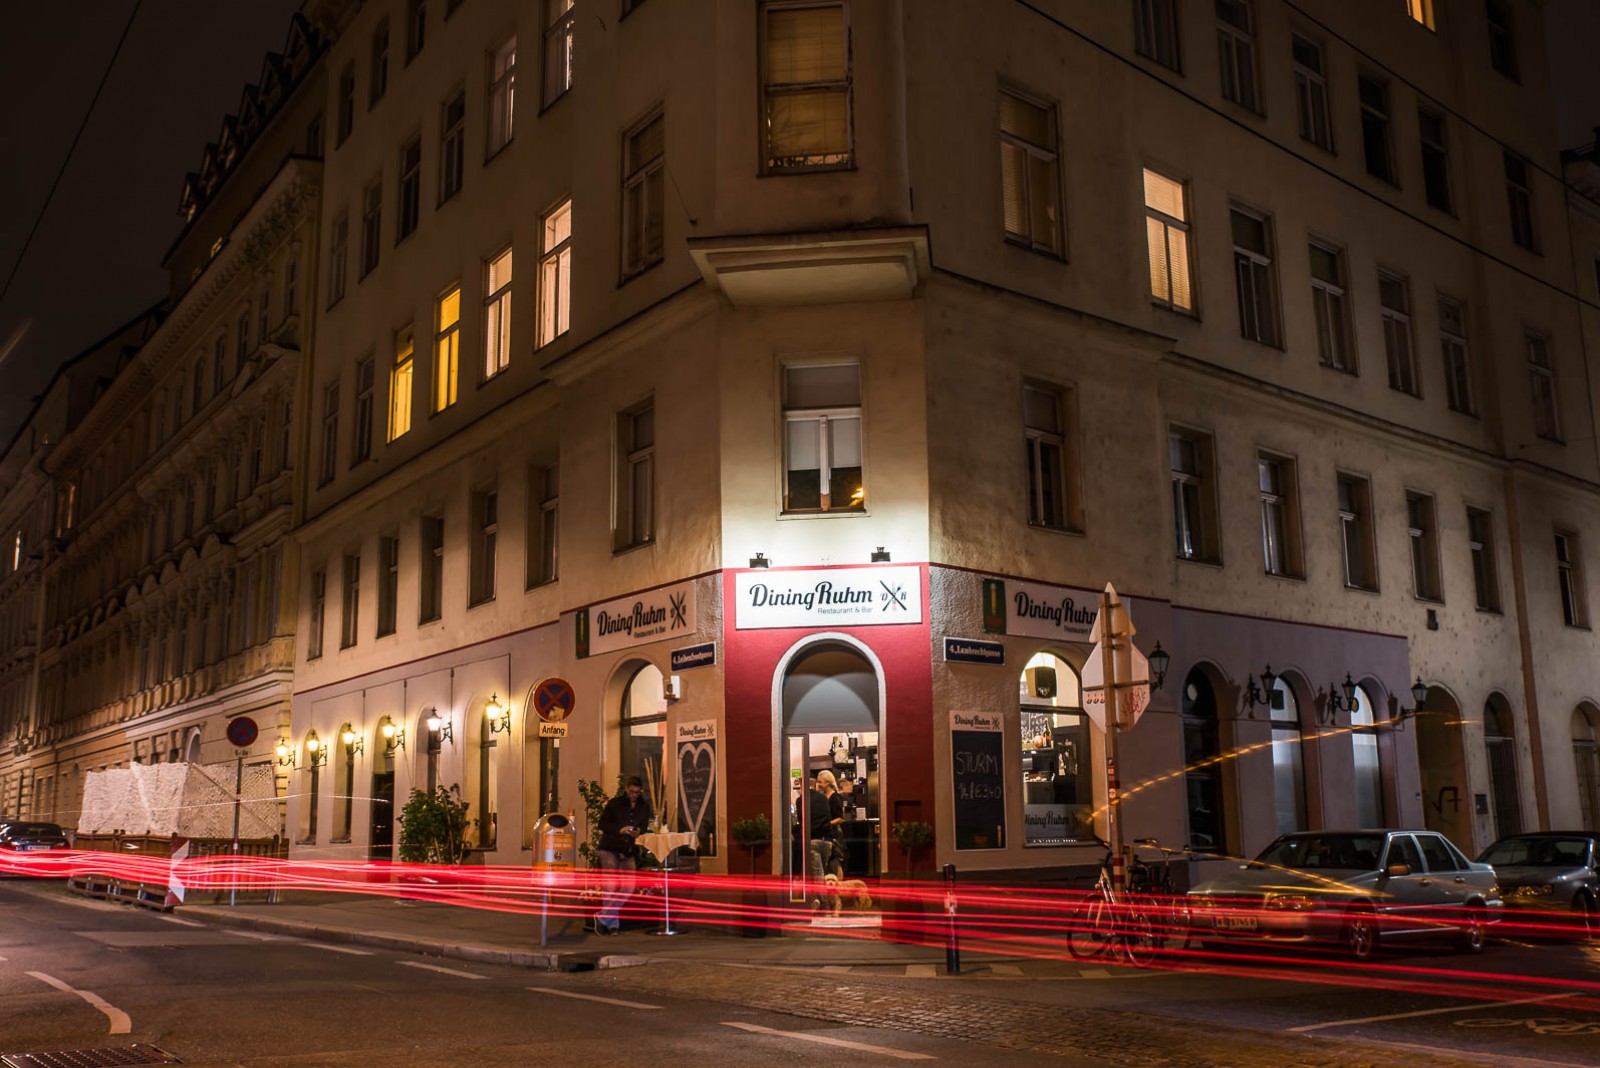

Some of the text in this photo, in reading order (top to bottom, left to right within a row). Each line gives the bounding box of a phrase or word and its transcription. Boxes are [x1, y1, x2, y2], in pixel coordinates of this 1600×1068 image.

[817, 607, 853, 615] Restaurant
[542, 725, 565, 736] Anfang
[955, 751, 999, 777] STURM
